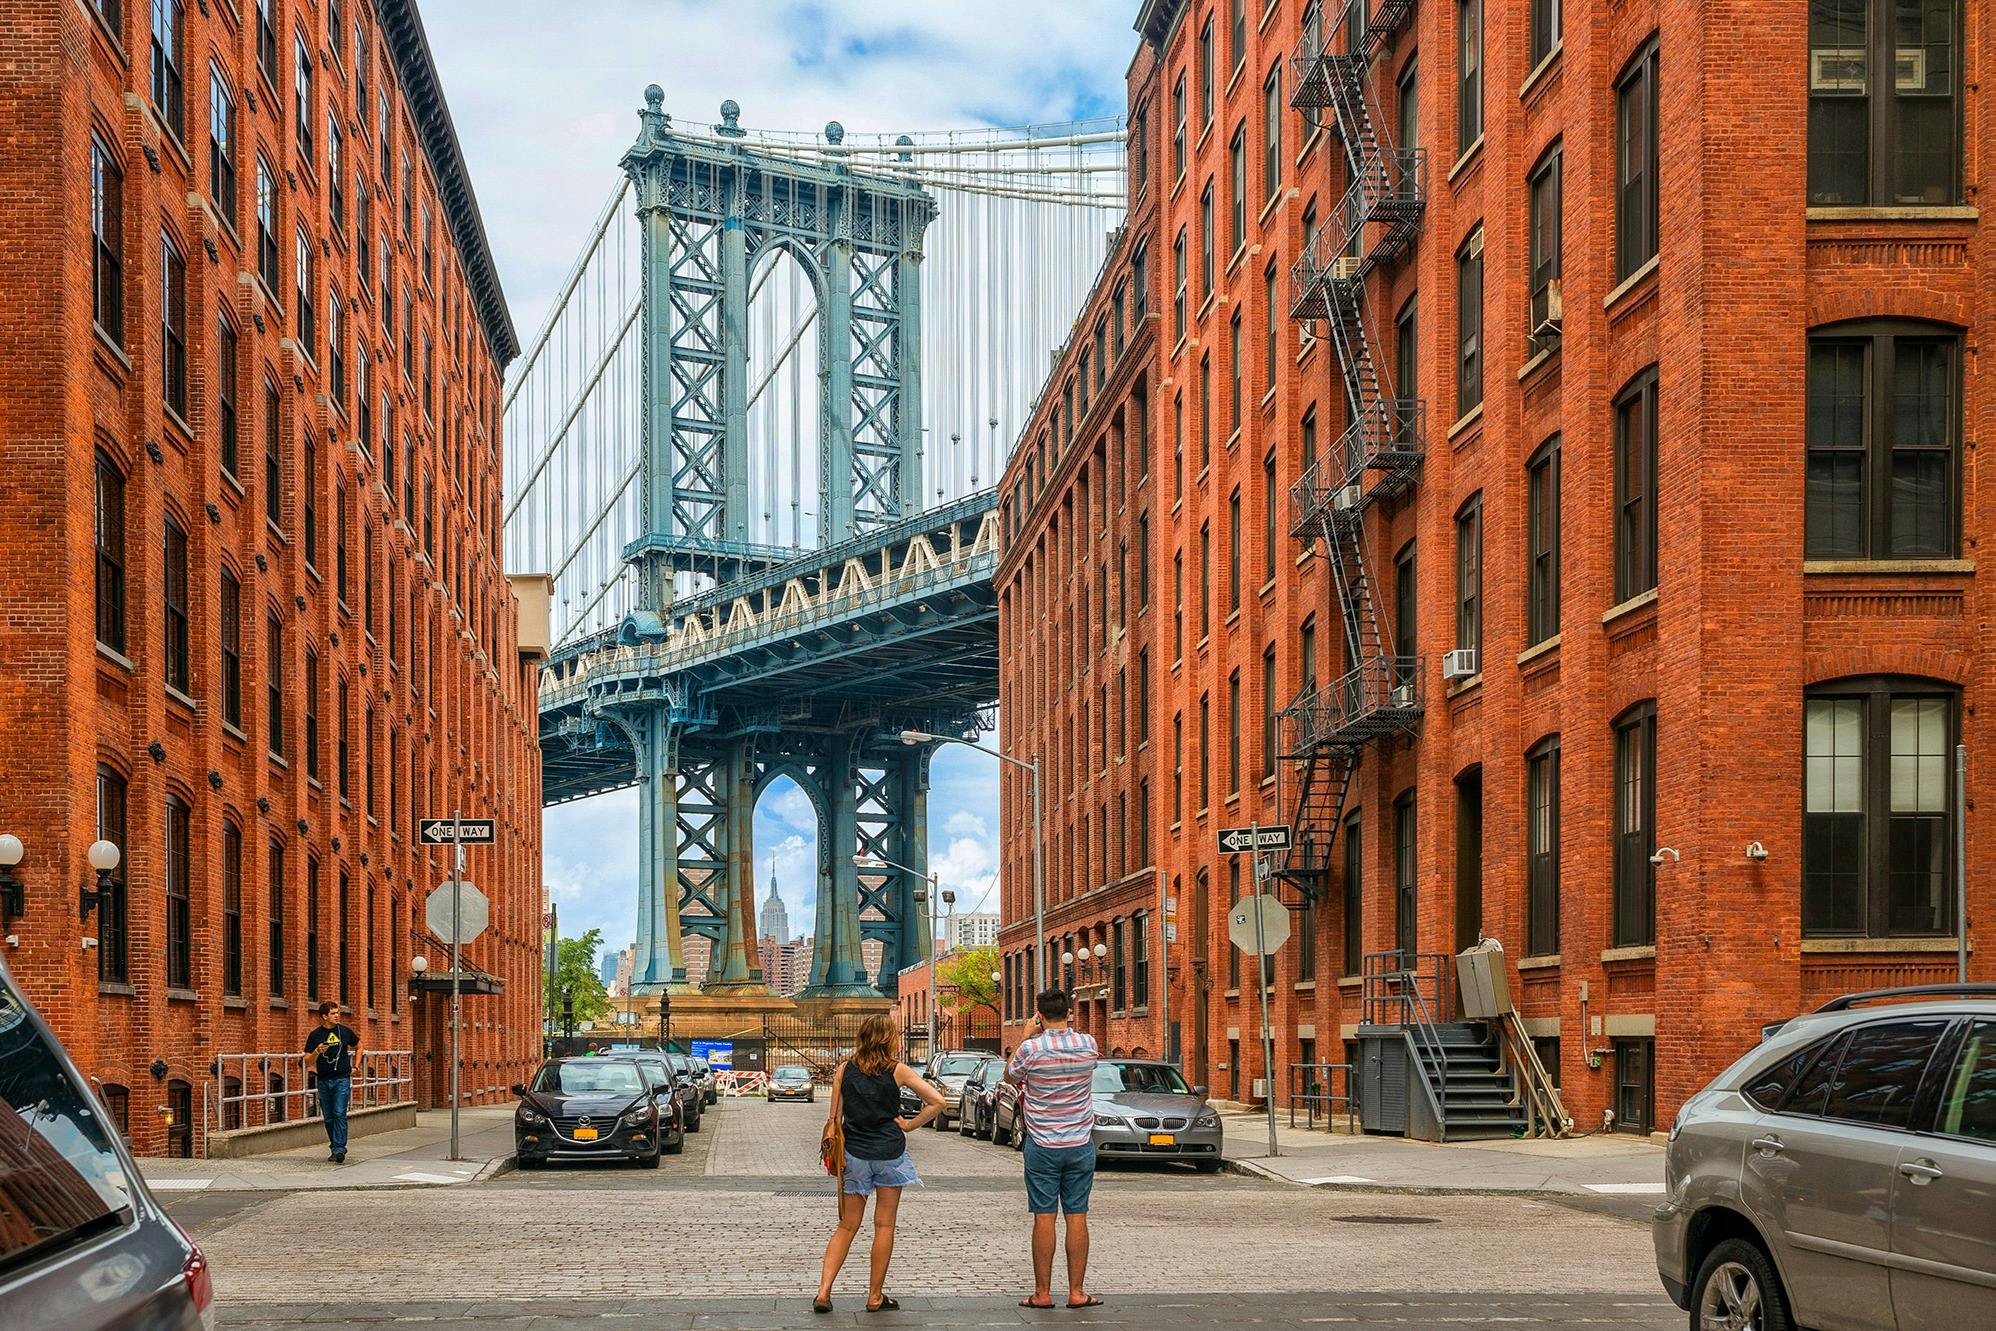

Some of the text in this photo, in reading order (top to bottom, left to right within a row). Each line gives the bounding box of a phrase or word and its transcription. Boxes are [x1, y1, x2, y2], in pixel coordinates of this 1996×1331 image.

[431, 827, 485, 836] ONE WAY
[1229, 834, 1280, 845] ONE WAY
